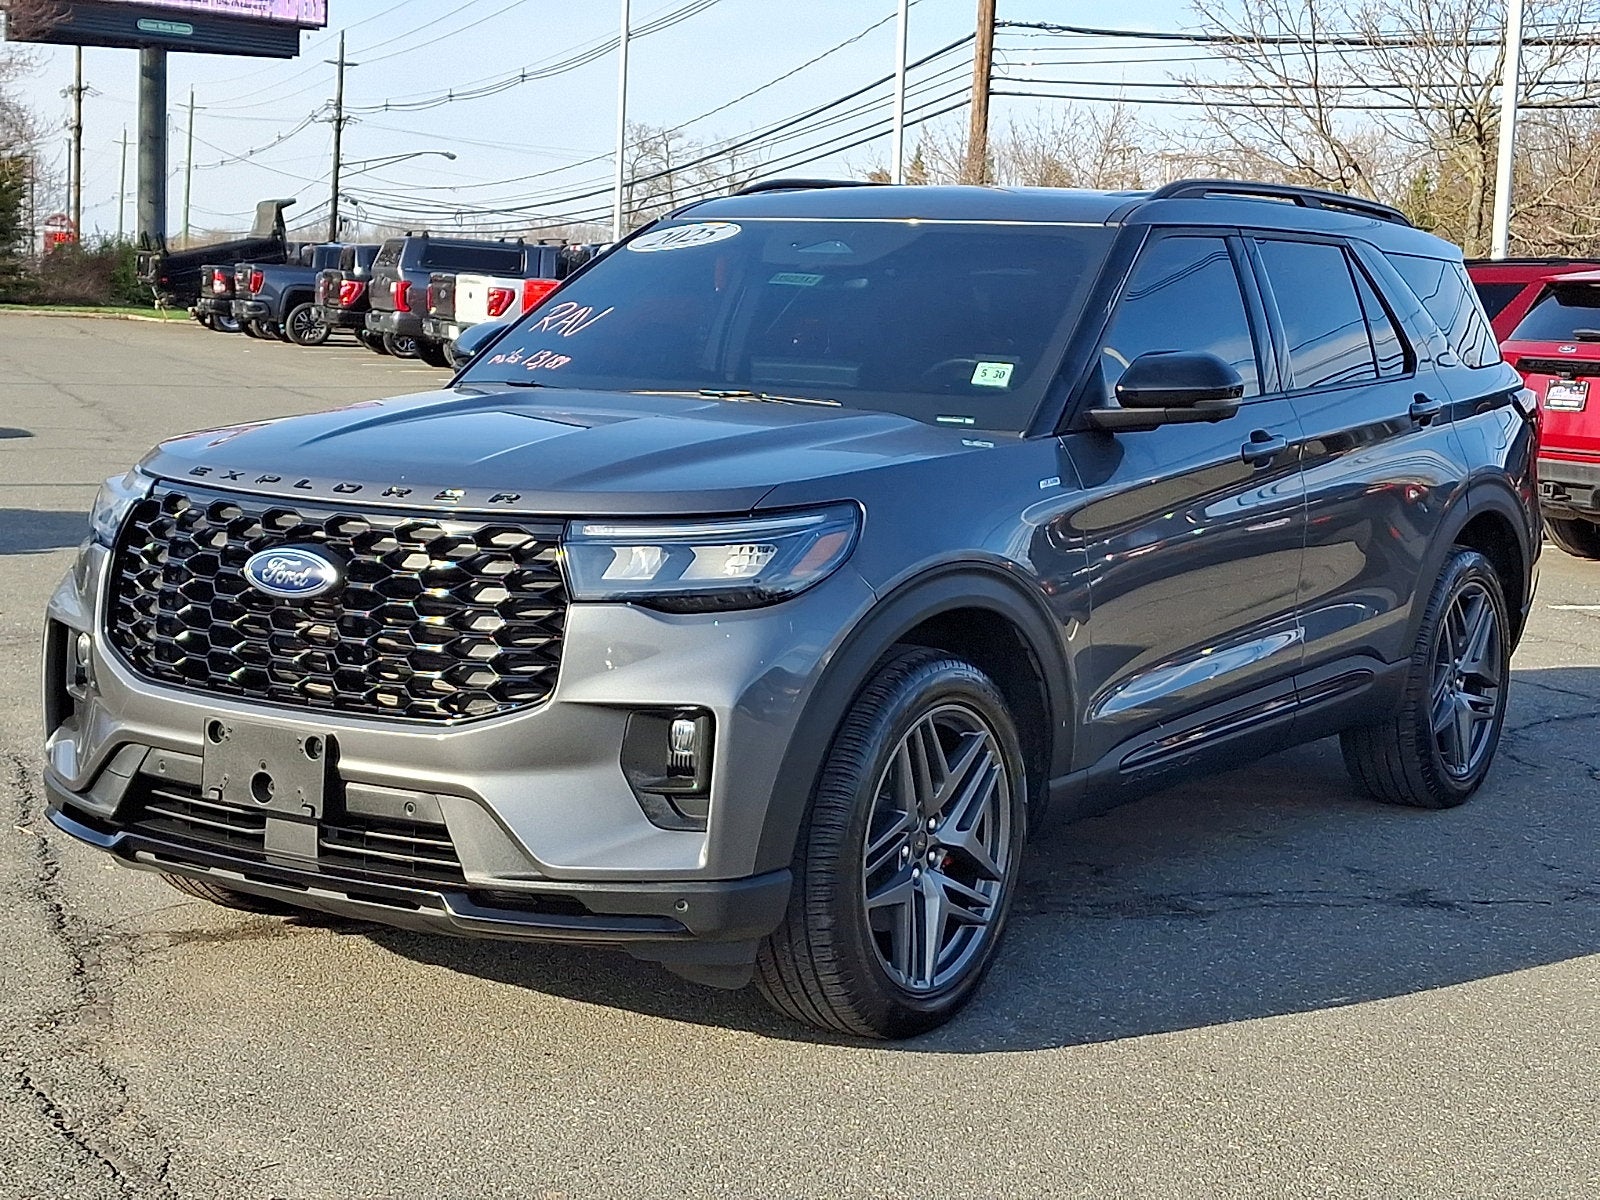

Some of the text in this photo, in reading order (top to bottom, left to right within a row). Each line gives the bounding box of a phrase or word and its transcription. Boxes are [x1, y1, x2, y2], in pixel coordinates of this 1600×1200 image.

[641, 225, 730, 248] 2025
[980, 368, 1006, 379] 5 30
[188, 465, 521, 504] EXPLORER
[261, 556, 313, 587] Ford
